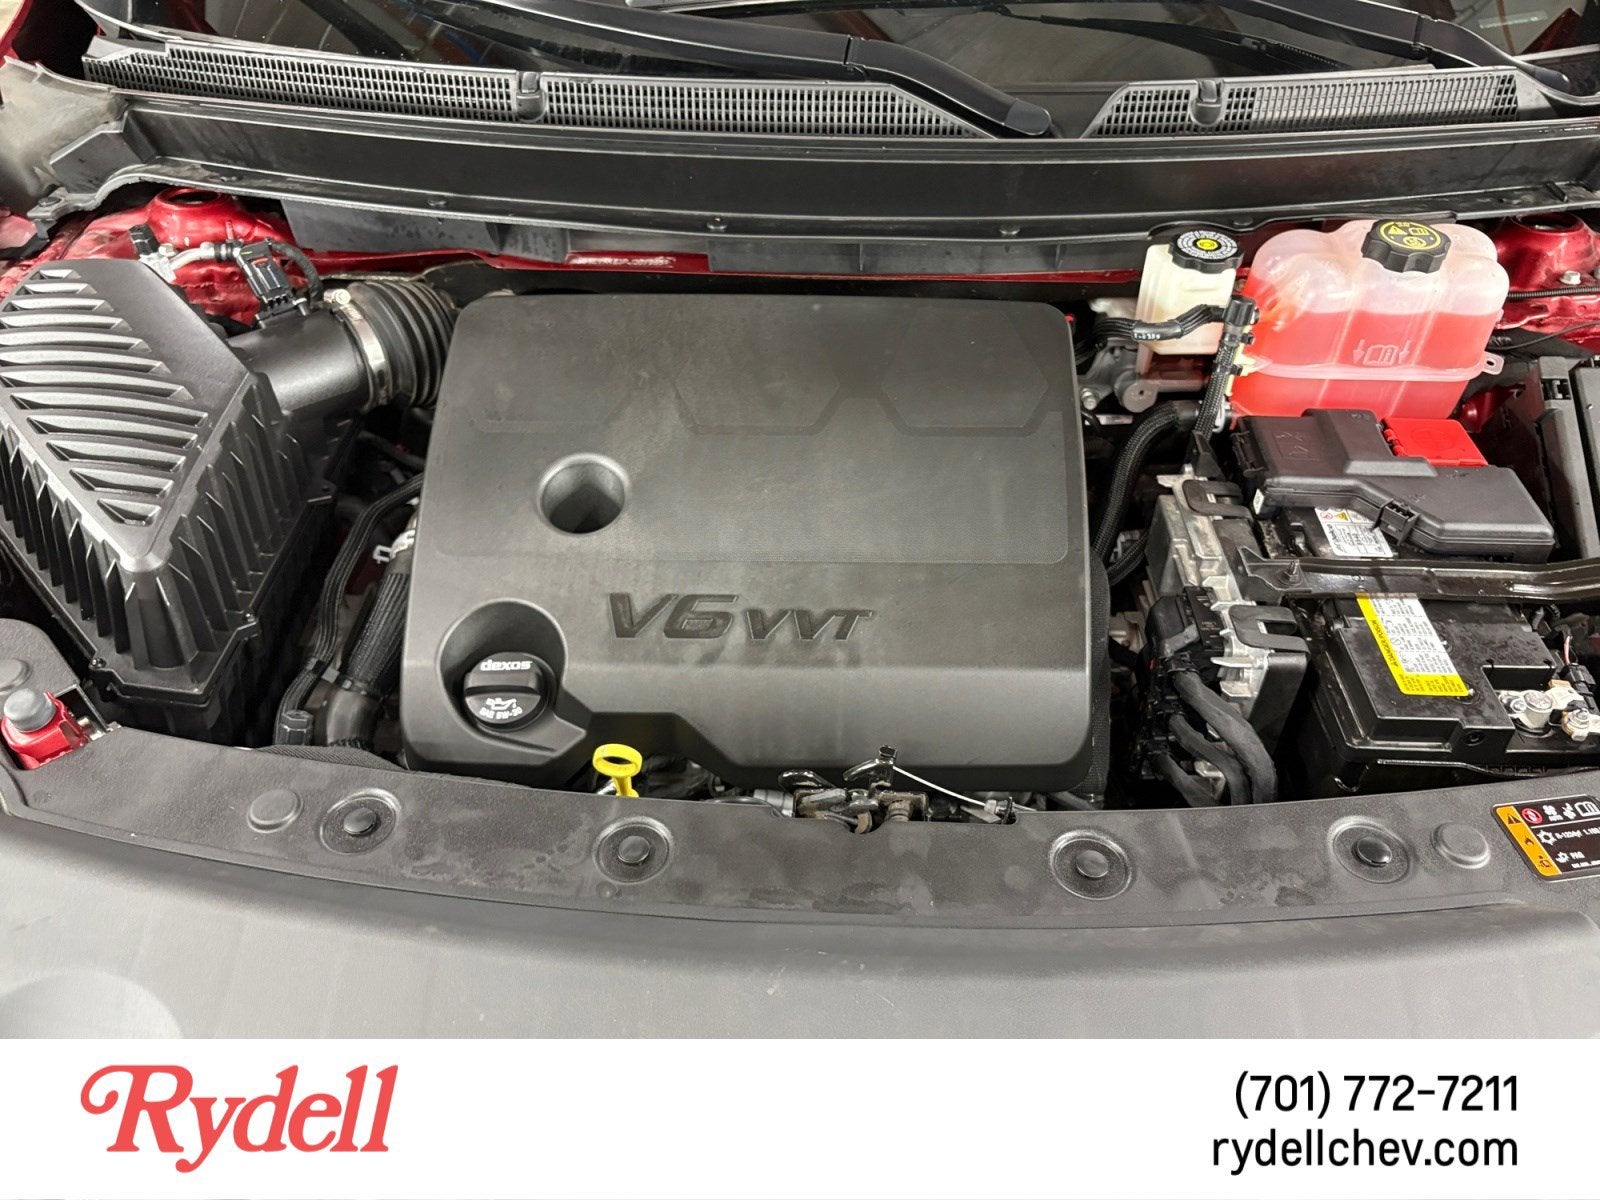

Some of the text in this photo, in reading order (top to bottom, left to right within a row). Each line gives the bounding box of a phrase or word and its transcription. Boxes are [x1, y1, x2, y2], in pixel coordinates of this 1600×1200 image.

[609, 592, 875, 640] V6 VVT
[480, 659, 532, 671] dexos
[479, 707, 523, 719] SAE 5W-30
